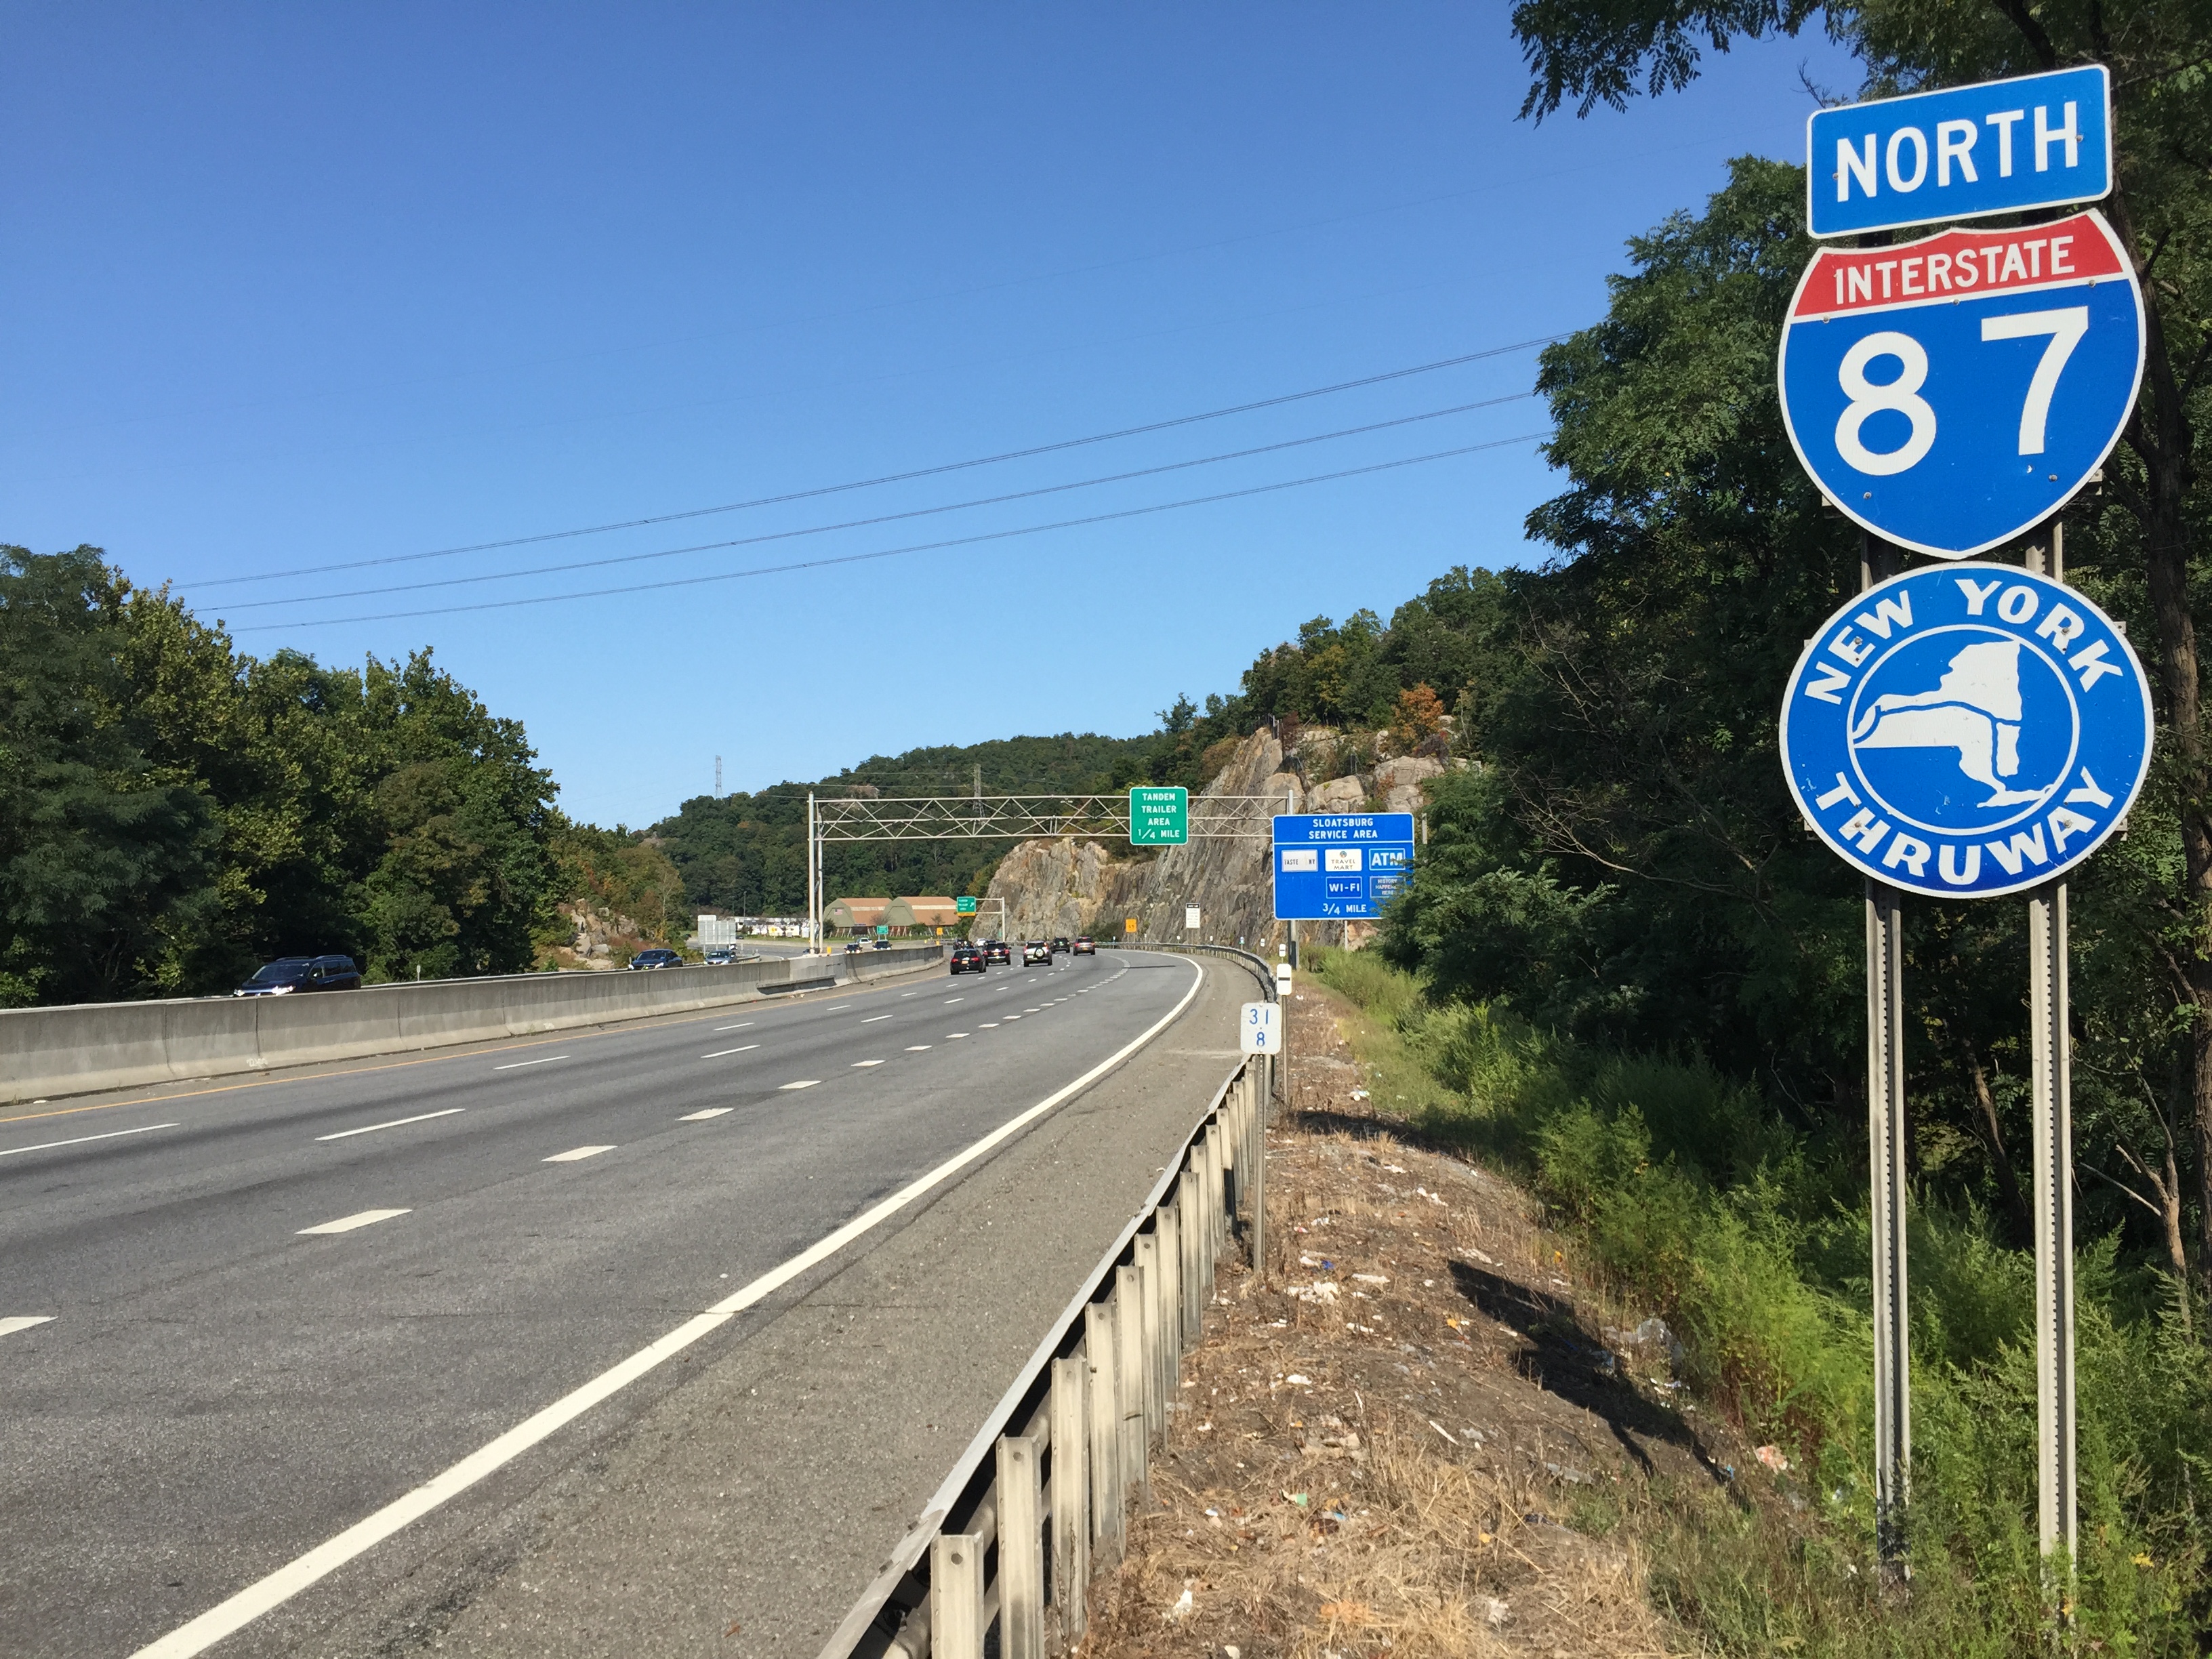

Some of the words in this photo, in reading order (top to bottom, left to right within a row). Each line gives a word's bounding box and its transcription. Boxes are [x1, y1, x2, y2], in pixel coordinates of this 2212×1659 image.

[1837, 101, 2079, 202] NORTH
[1835, 235, 2075, 304] INTERSTATE
[1835, 306, 2089, 476] 87
[1805, 590, 1913, 705] NEW
[1955, 579, 2123, 693] YORK
[1142, 793, 1176, 801] TANDEM
[1141, 805, 1176, 813] TRAILER
[1313, 818, 1373, 827] SLOATSBURG
[1816, 766, 2114, 885] THRUWAY
[1138, 828, 1155, 839] 1/4
[1160, 830, 1180, 838] MILE
[1309, 830, 1347, 839] SERVICE
[1353, 830, 1378, 838] AREA
[1371, 853, 1403, 866] ATM
[1329, 883, 1359, 893] WI-FI
[1322, 903, 1340, 915] 3/4
[1346, 904, 1367, 913] MILE
[1249, 1008, 1269, 1025] 31
[1256, 1031, 1265, 1046] 8
